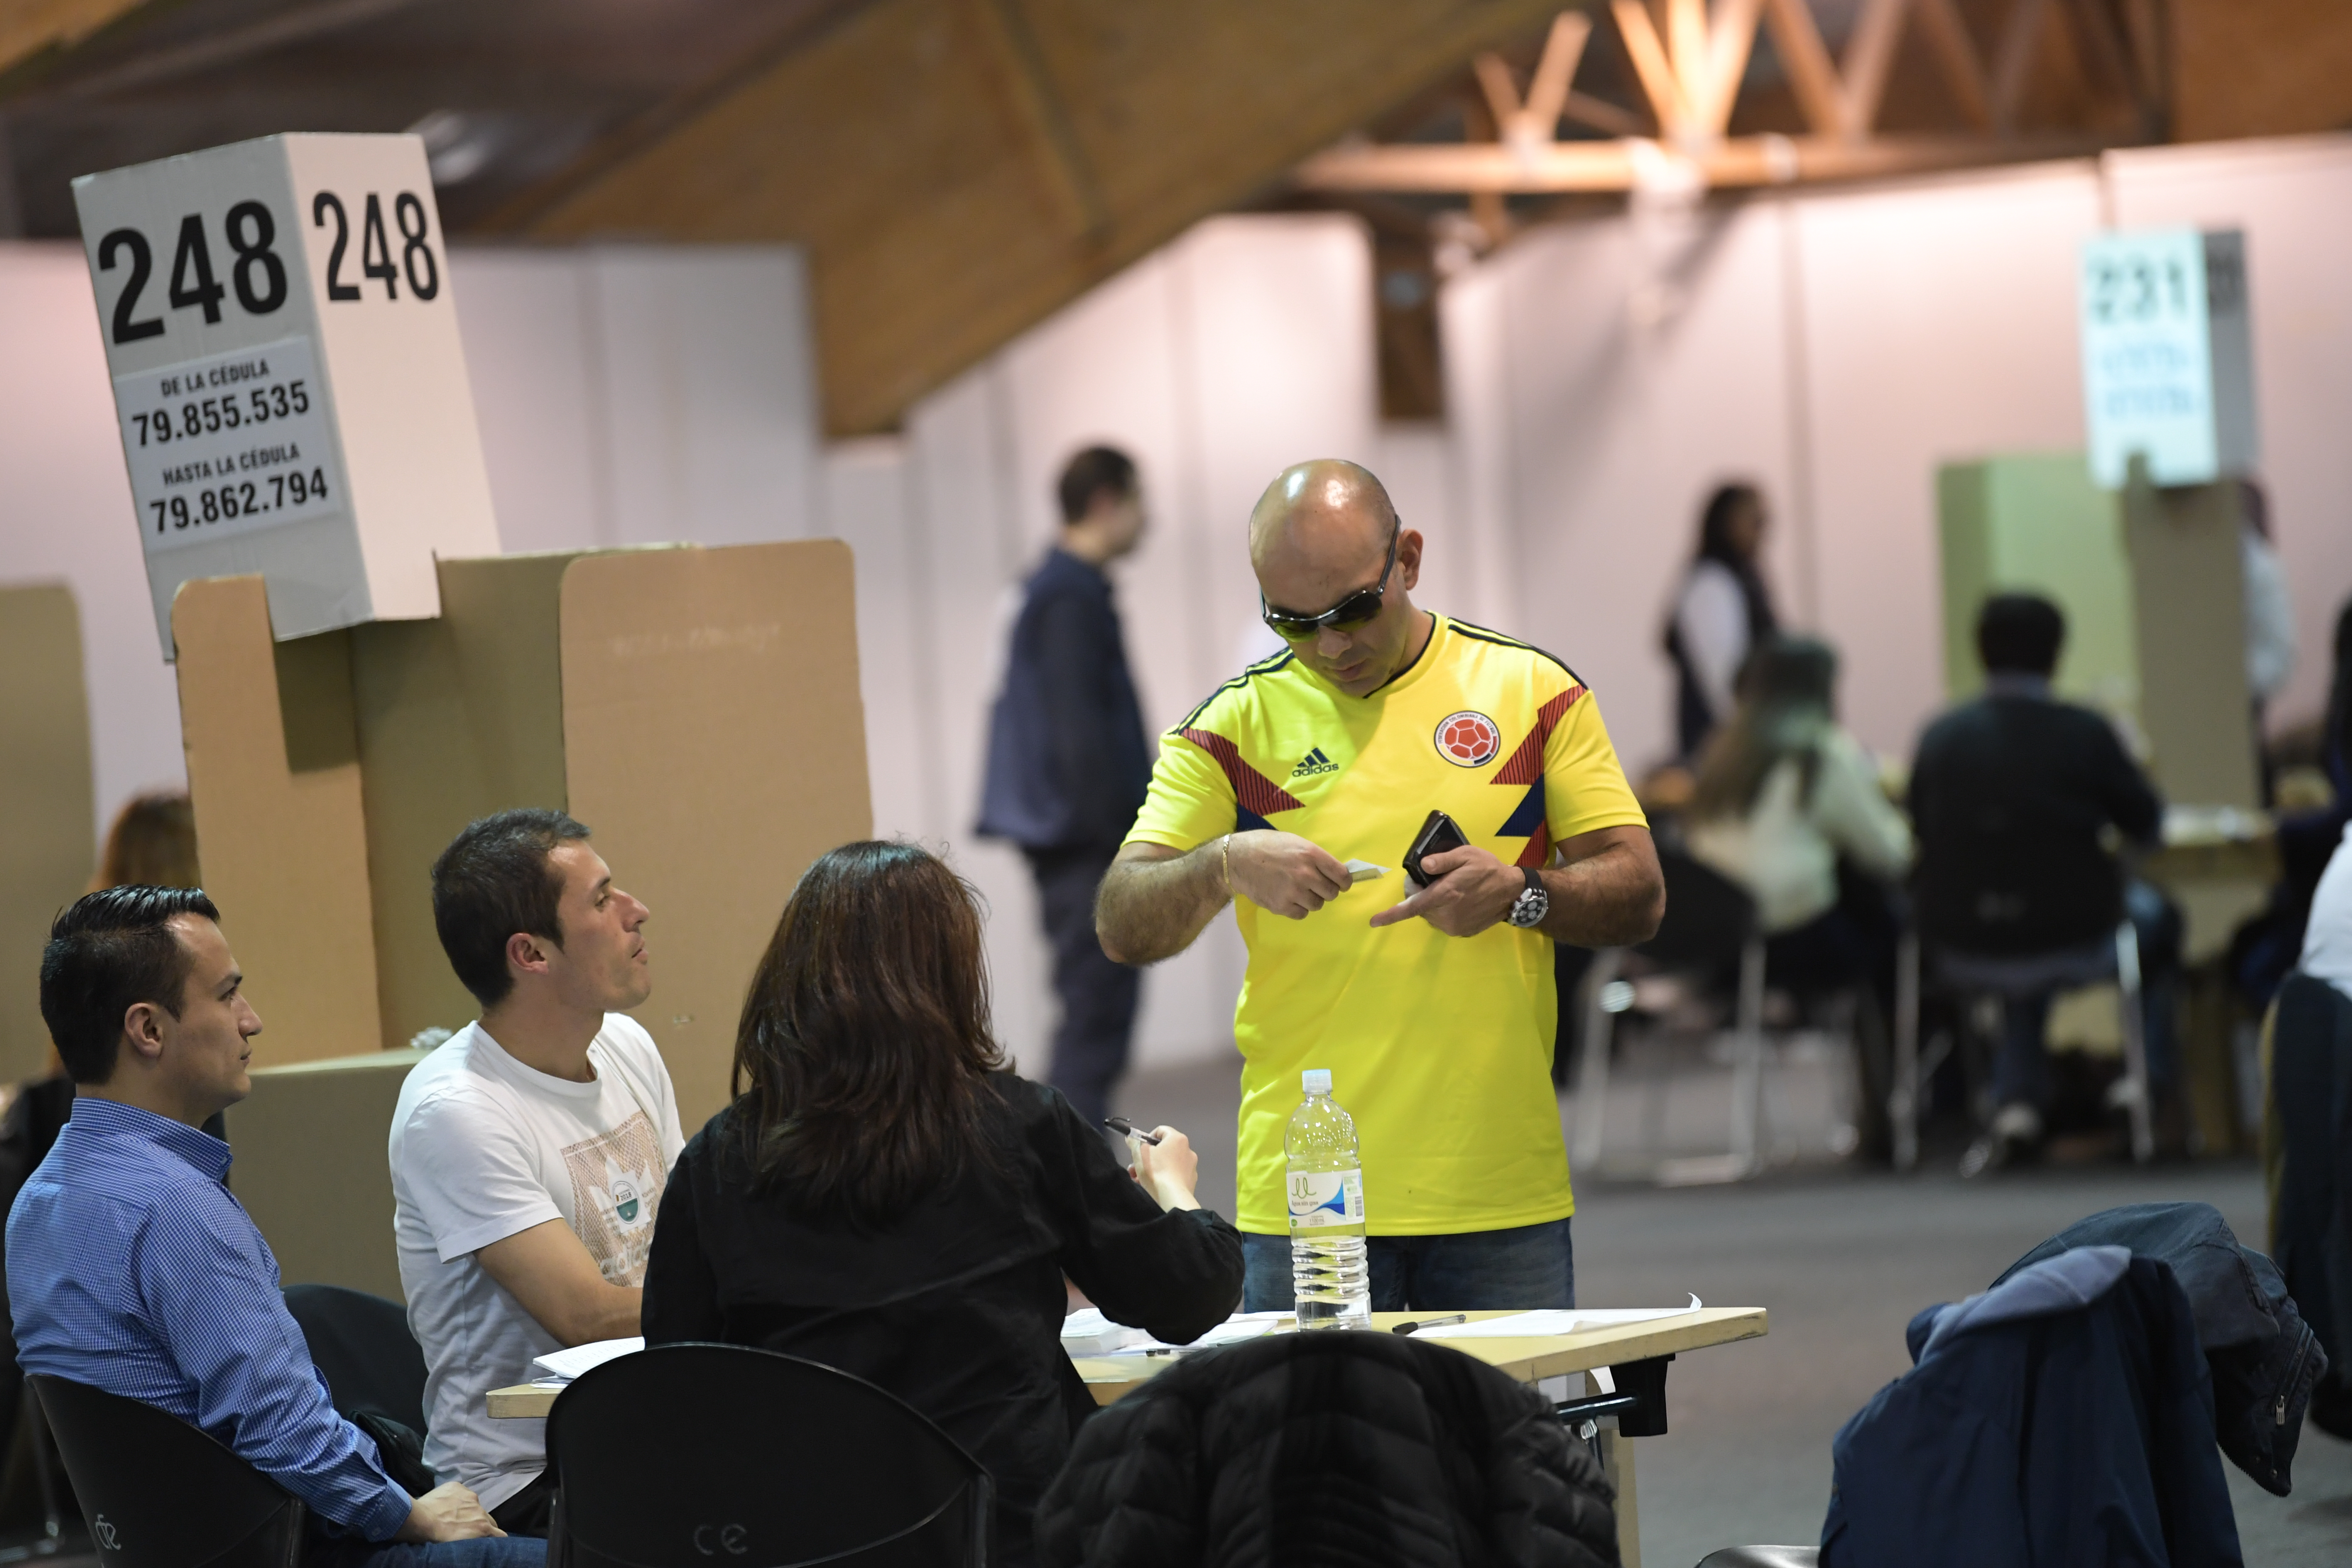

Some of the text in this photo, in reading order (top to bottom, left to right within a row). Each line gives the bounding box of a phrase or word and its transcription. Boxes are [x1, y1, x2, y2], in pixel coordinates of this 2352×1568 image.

[98, 200, 287, 344] 248
[313, 190, 438, 303] 248
[161, 359, 270, 397] DE LA CÉDULA
[132, 380, 309, 446] 79.855.535
[163, 461, 212, 486] HASTA
[216, 455, 234, 476] LA
[150, 466, 328, 533] 79.862.794
[1292, 763, 1339, 777] adidas
[620, 1192, 632, 1200] 2018
